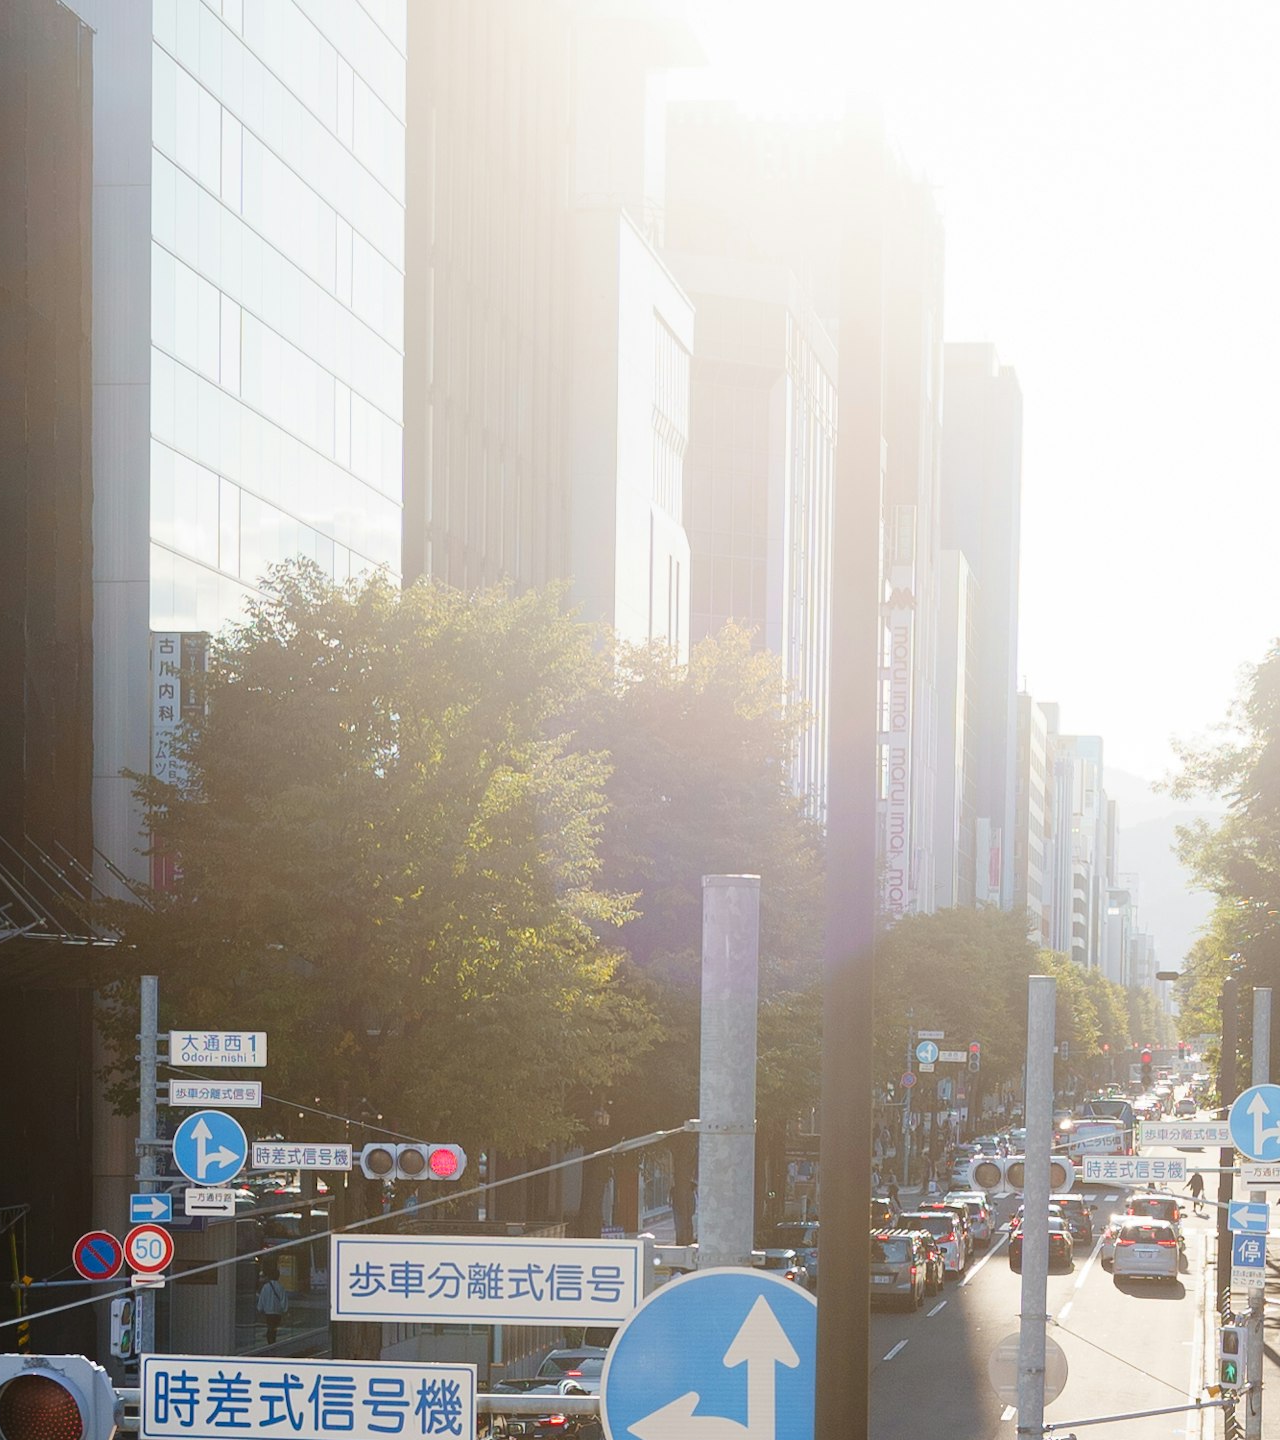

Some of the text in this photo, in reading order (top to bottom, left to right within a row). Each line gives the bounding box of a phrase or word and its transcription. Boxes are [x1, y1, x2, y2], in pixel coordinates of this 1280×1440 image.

[158, 638, 175, 721] 古川内科
[181, 1052, 247, 1063] Odori-nishi
[175, 1087, 256, 1101] 歩車分離式信号
[1144, 1128, 1229, 1141] 歩車分離式信号
[255, 1145, 349, 1167] 時差式信号機
[1086, 1160, 1183, 1179] 時差式信号機
[188, 1192, 233, 1203] 一方通行路
[135, 1238, 163, 1260] 50
[1238, 1239, 1261, 1262] 停
[349, 1261, 625, 1303] 歩車分離式信号
[154, 1369, 463, 1436] 時差式信号機
